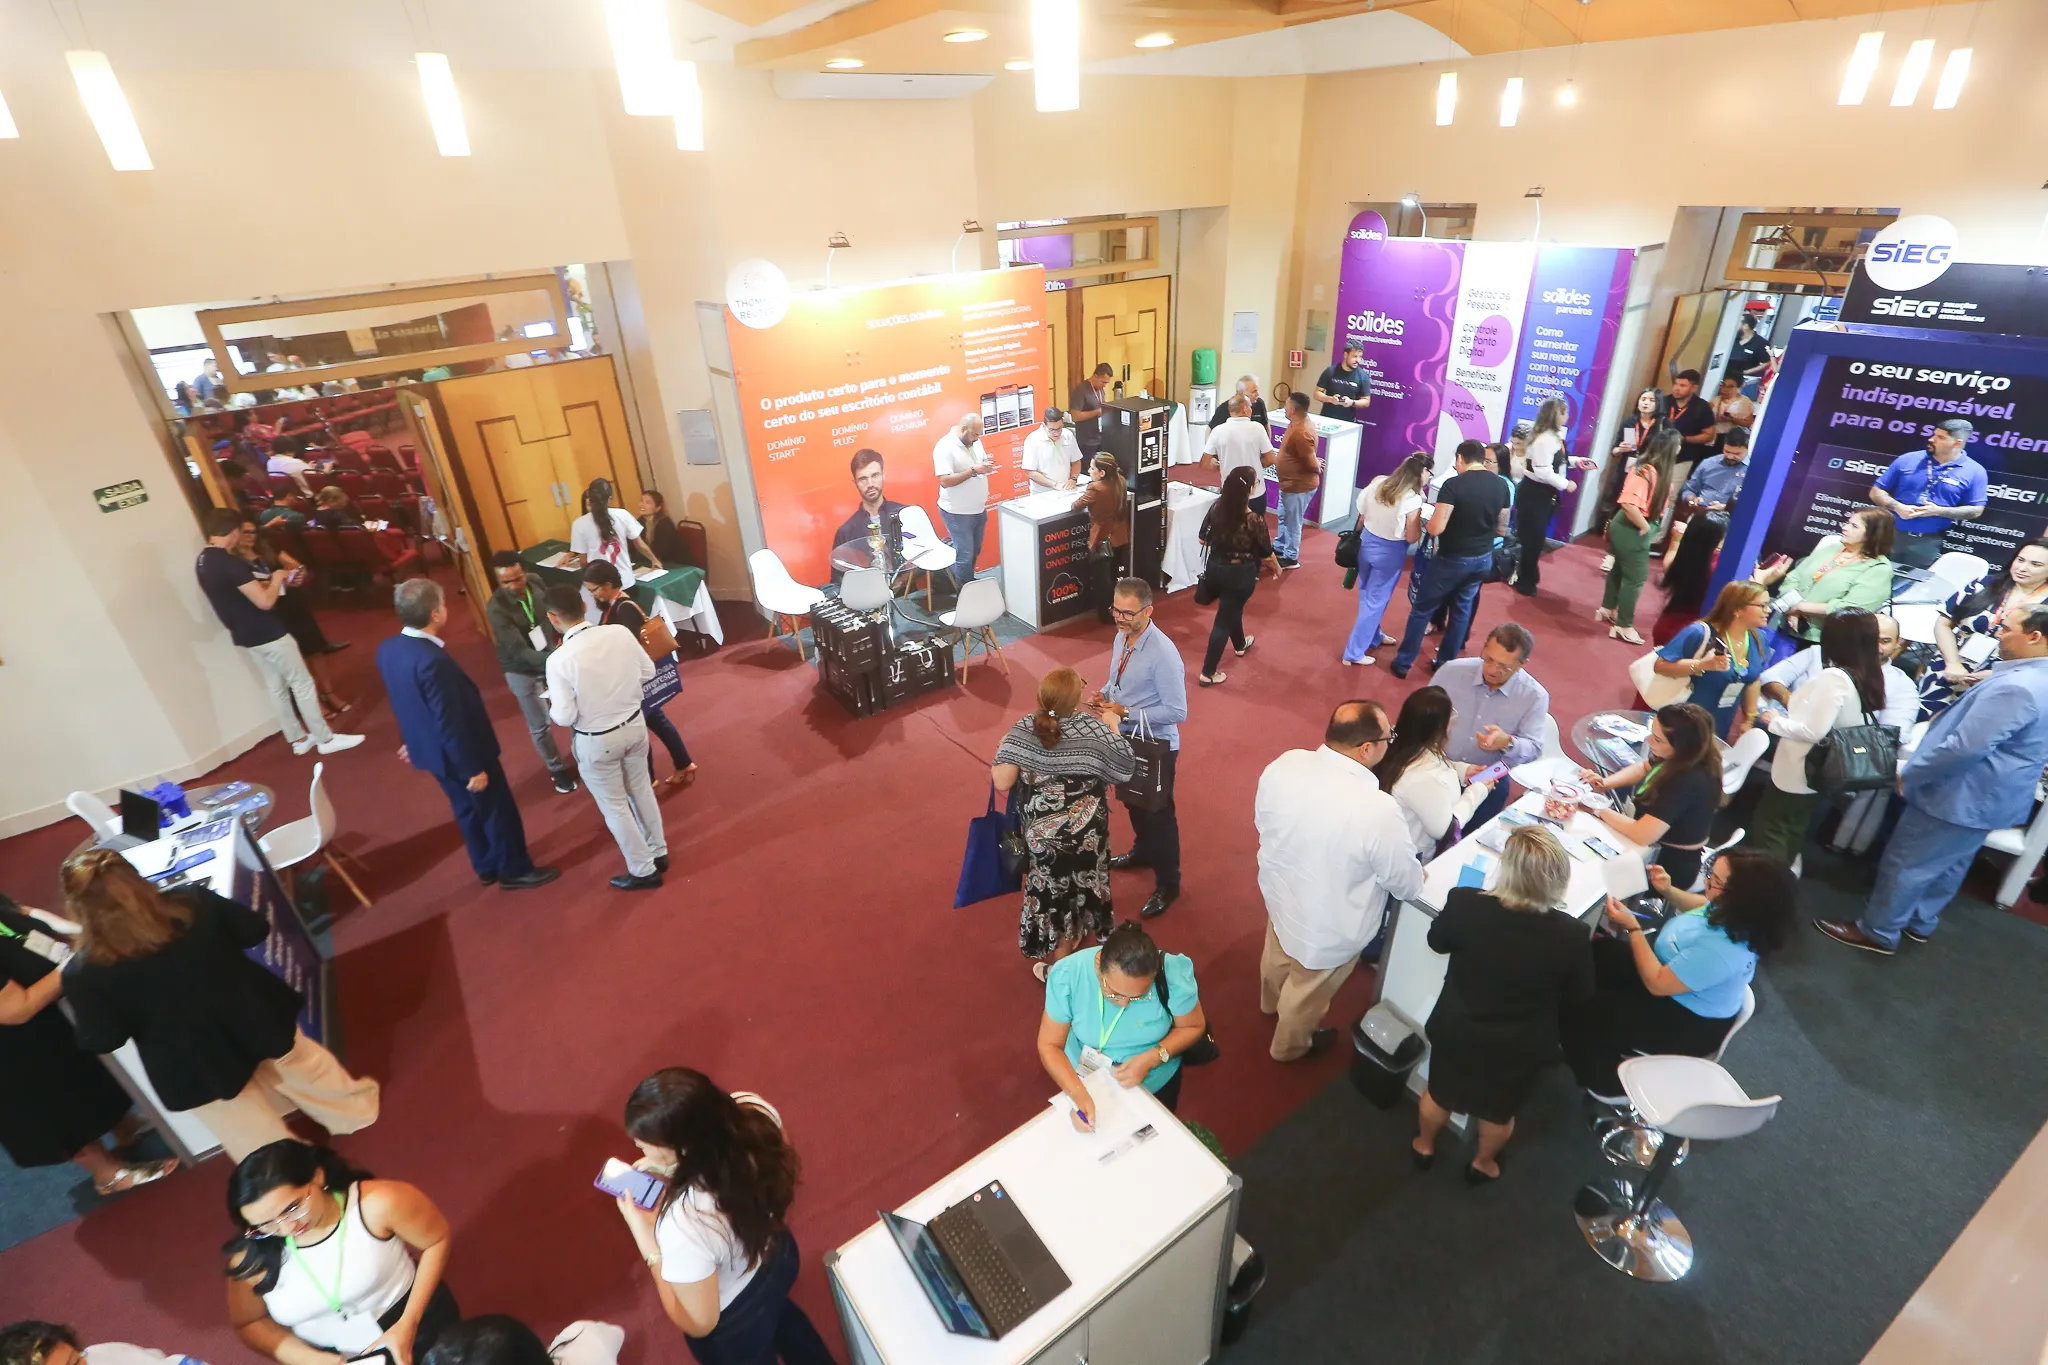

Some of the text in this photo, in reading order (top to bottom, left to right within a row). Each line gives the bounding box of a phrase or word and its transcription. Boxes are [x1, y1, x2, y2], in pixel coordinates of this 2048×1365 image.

[1466, 299, 1500, 311] Pessoas
[1555, 305, 1593, 316] parceiros
[1463, 323, 1498, 335] Controle
[1536, 326, 1564, 338] Como
[1460, 334, 1497, 347] de Ponto
[1533, 339, 1579, 352] aumentar
[1459, 345, 1486, 358] Digital
[1531, 350, 1576, 364] sua renda
[1529, 362, 1580, 377] com o novo
[1370, 378, 1395, 389] umanos
[1454, 378, 1502, 393] Corporativos
[1527, 374, 1573, 388] modelo de
[1849, 362, 2011, 395] o seu serviço
[760, 398, 772, 411] O
[774, 389, 825, 410] produto
[827, 383, 858, 398] certo
[859, 377, 887, 394] para
[888, 375, 897, 386] o
[898, 365, 951, 384] momento
[764, 381, 943, 430] certo do seu escritório contábil
[1450, 398, 1485, 412] Portal de
[1522, 395, 1535, 406] da
[1841, 383, 2016, 421] indispensável
[1449, 409, 1475, 422] Vagas
[1830, 411, 1884, 430] para
[1888, 419, 1917, 434] os
[831, 421, 869, 437] DOMÍNIO
[766, 435, 806, 451] DOMÍNIO
[1815, 492, 1851, 506] Elimine
[1806, 515, 1829, 525] para
[1044, 523, 1091, 543] ONVIO CONT
[1960, 519, 2026, 538] ferramenta
[1045, 537, 1089, 556] ONVIO FISC
[1965, 534, 2017, 549] gestores
[1045, 555, 1070, 569] ONVIO
[1051, 583, 1079, 599] 100%
